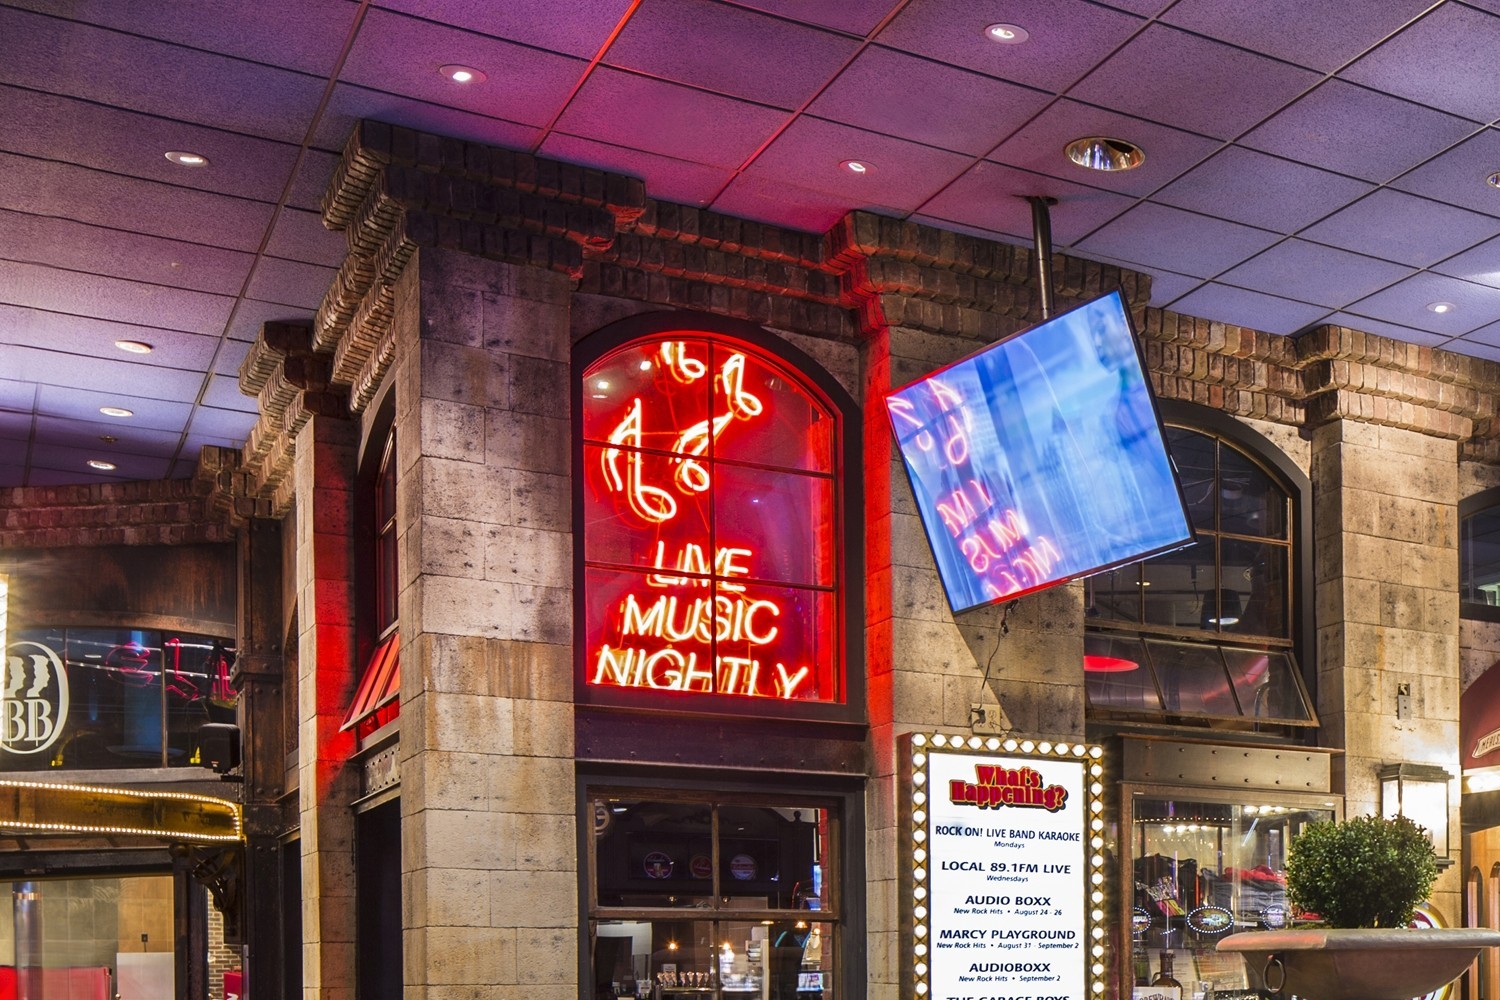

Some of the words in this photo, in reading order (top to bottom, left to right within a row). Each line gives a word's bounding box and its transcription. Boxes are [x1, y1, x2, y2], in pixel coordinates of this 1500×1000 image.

[655, 540, 752, 592] LIVE
[623, 595, 779, 645] MUSIC
[594, 643, 809, 700] NIGHTLY
[976, 764, 1041, 788] What's
[949, 779, 1068, 812] Happening?
[936, 825, 963, 836] ROCK
[965, 827, 983, 837] ON!
[987, 828, 1006, 838] LIVE
[1010, 829, 1036, 840] BAND
[1039, 831, 1080, 842] KARAOKE
[994, 841, 1025, 849] Mondays
[942, 861, 986, 872] LOCAL
[990, 862, 1039, 873] 89.1FM
[1043, 864, 1071, 874] LIVE
[987, 875, 1029, 883] Wednesdays
[965, 895, 1011, 906] AUDIO
[1015, 896, 1051, 906] BOXX
[1014, 909, 1039, 917] August
[940, 930, 987, 939] MARCY
[992, 930, 1076, 940] PLAYGROUND
[998, 942, 1022, 950] August
[1038, 942, 1074, 950] September
[969, 963, 1051, 973] AUDIOBOXX
[1019, 975, 1055, 983] September
